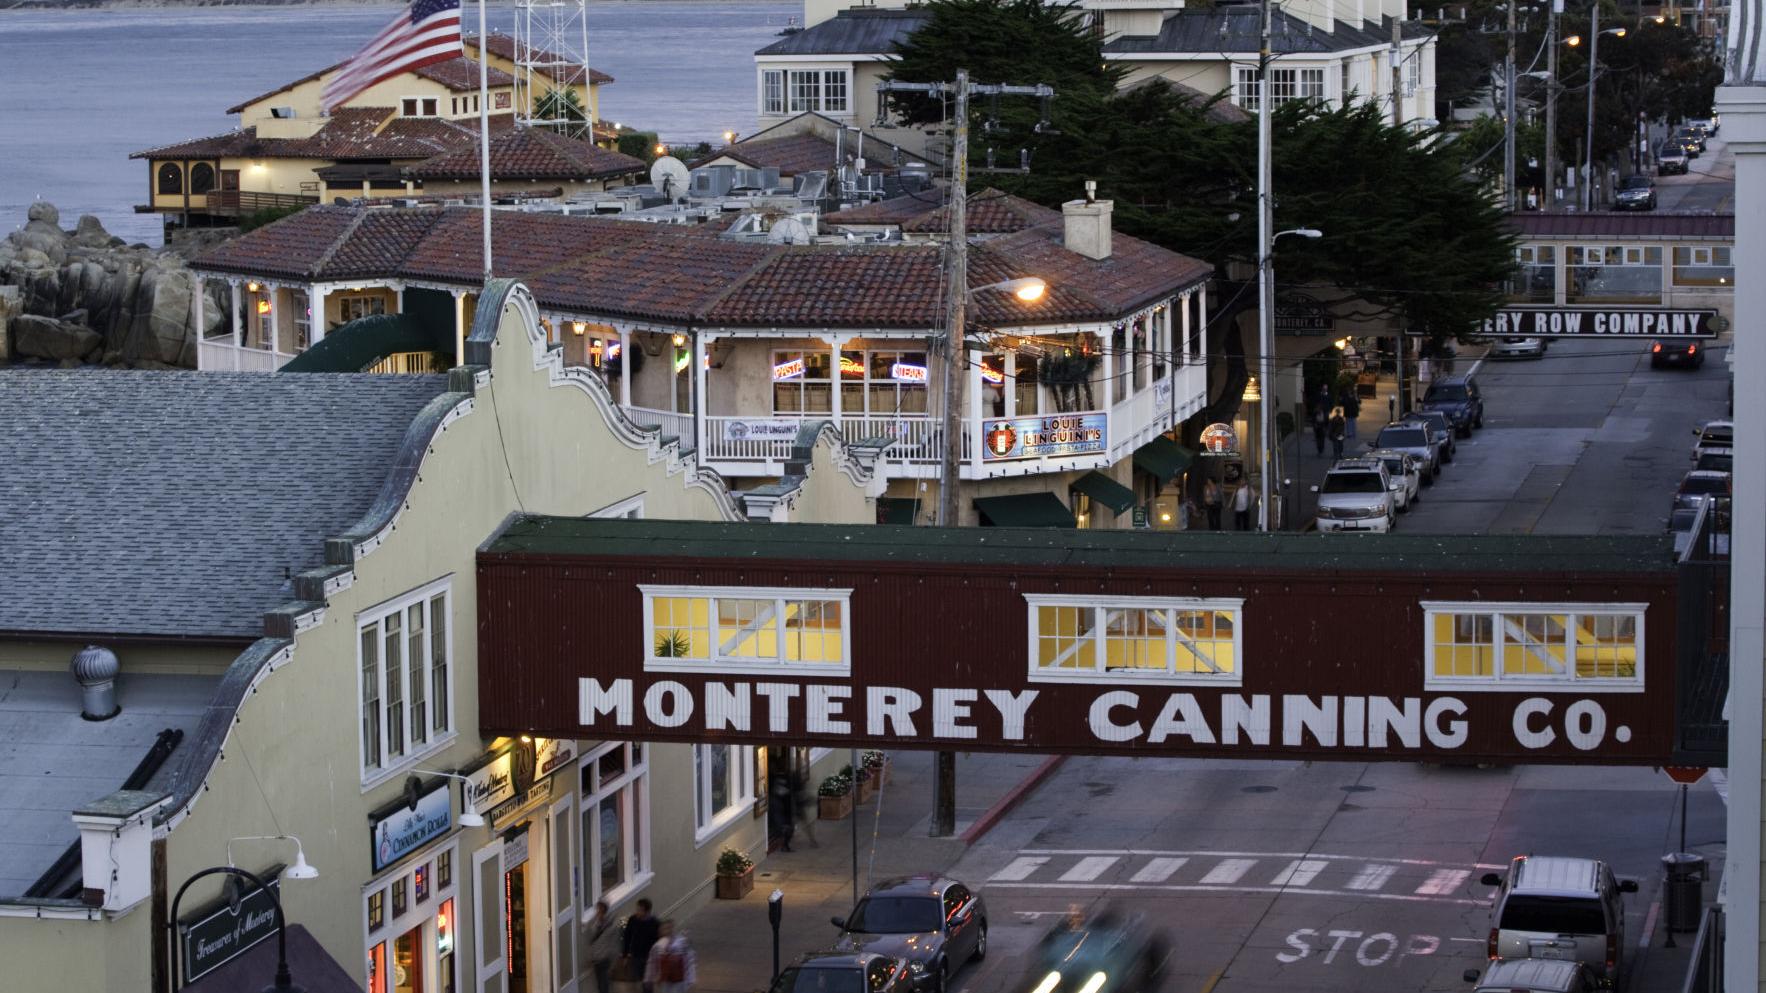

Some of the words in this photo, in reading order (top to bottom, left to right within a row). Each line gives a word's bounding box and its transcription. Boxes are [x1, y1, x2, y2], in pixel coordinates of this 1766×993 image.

[1534, 312, 1582, 334] ROW
[1594, 312, 1701, 335] COMPANY
[774, 360, 803, 377] PASTA
[751, 424, 768, 434] LOUIE
[1042, 417, 1084, 431] LOUIE
[1024, 429, 1102, 446] LINGUINI'S
[577, 676, 1040, 741] MONTEREY
[1088, 690, 1469, 750] CANNING
[1512, 696, 1632, 751] CO.
[196, 932, 232, 961] Treasures
[233, 918, 243, 945] of
[241, 908, 275, 935] Monterey
[1275, 928, 1441, 967] STOP
